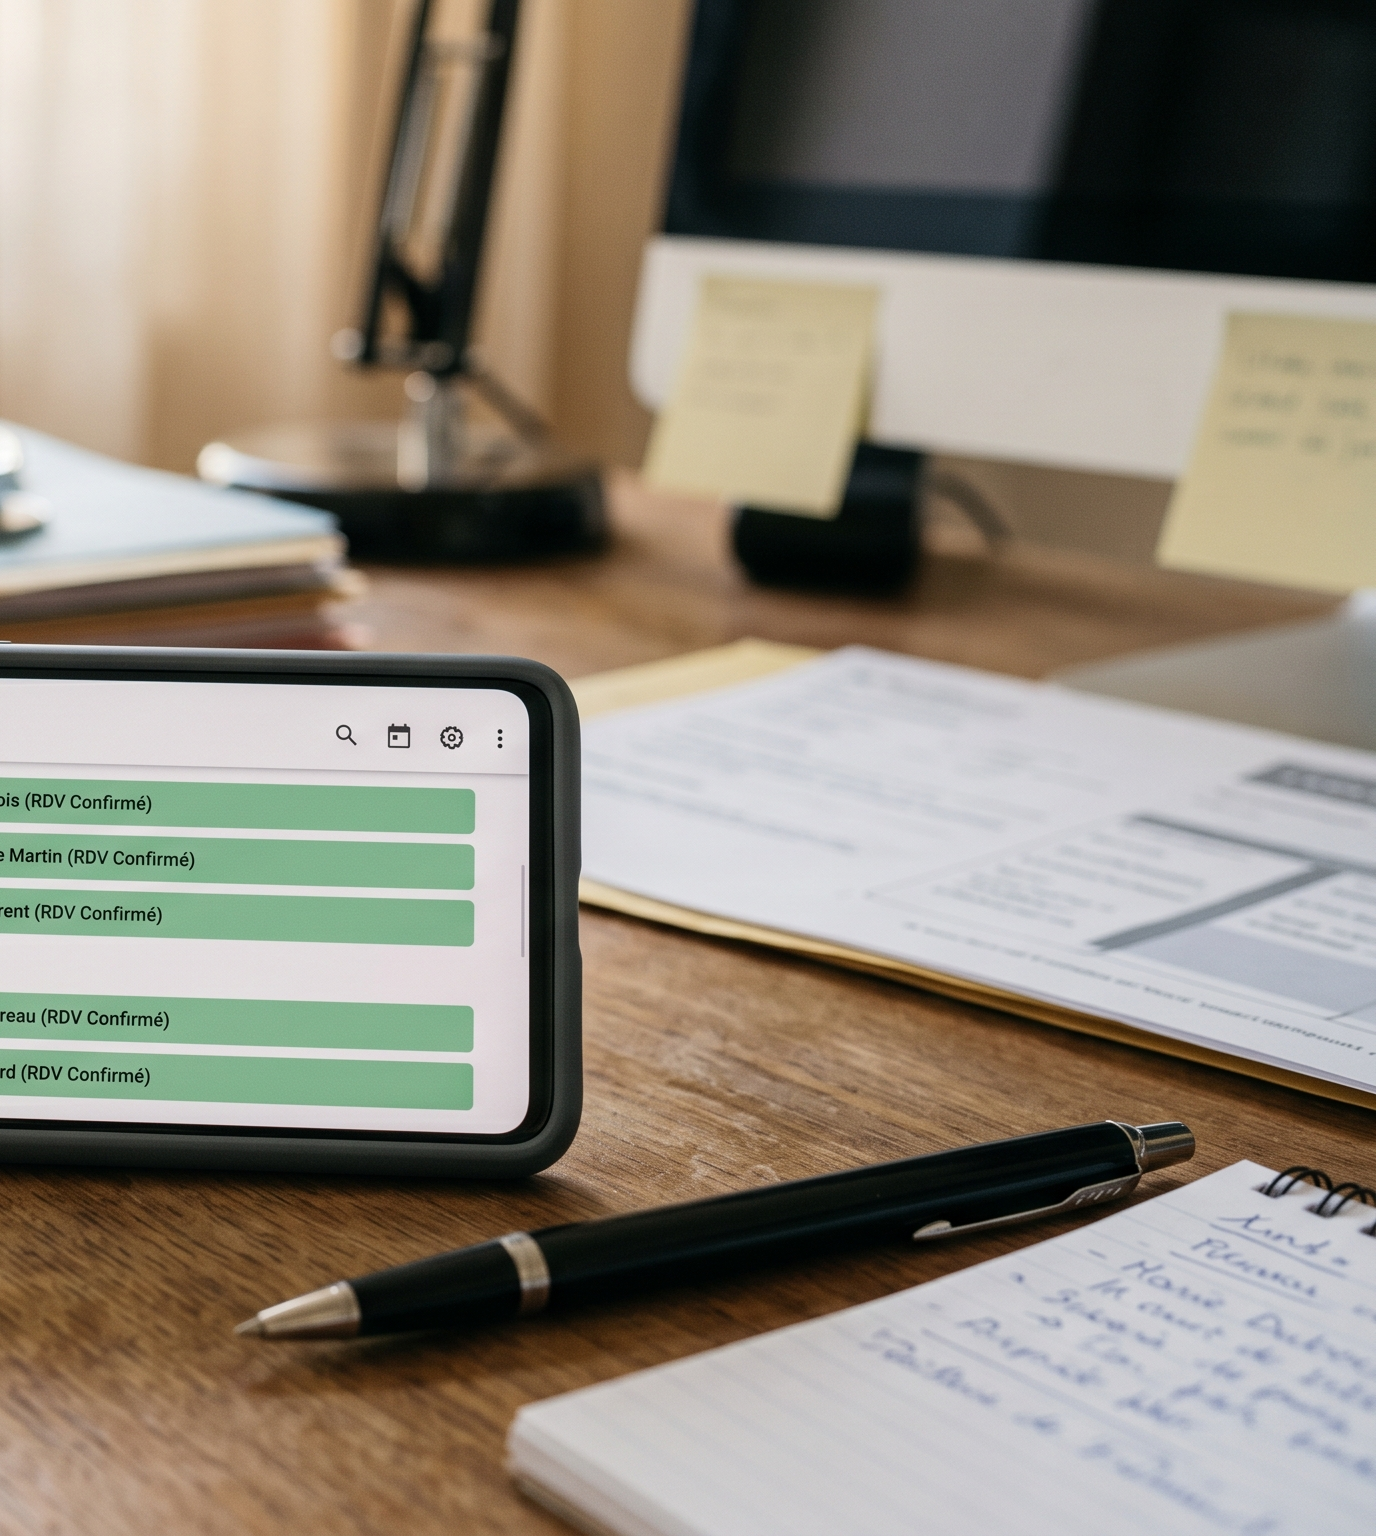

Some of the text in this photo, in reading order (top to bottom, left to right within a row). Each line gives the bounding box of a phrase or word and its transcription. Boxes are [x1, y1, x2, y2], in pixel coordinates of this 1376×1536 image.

[24, 791, 67, 812] (RDV
[69, 794, 152, 815] Confirmé)
[9, 847, 63, 864] Martin
[67, 848, 109, 868] (RDV
[112, 850, 195, 871] Confirmé)
[34, 902, 77, 923] (RDV
[80, 905, 163, 926] Confirmé)
[40, 1007, 83, 1028] (RDV
[86, 1010, 170, 1032] Confirmé)
[20, 1063, 64, 1084] (RDV
[67, 1066, 151, 1088] Confirmé)
